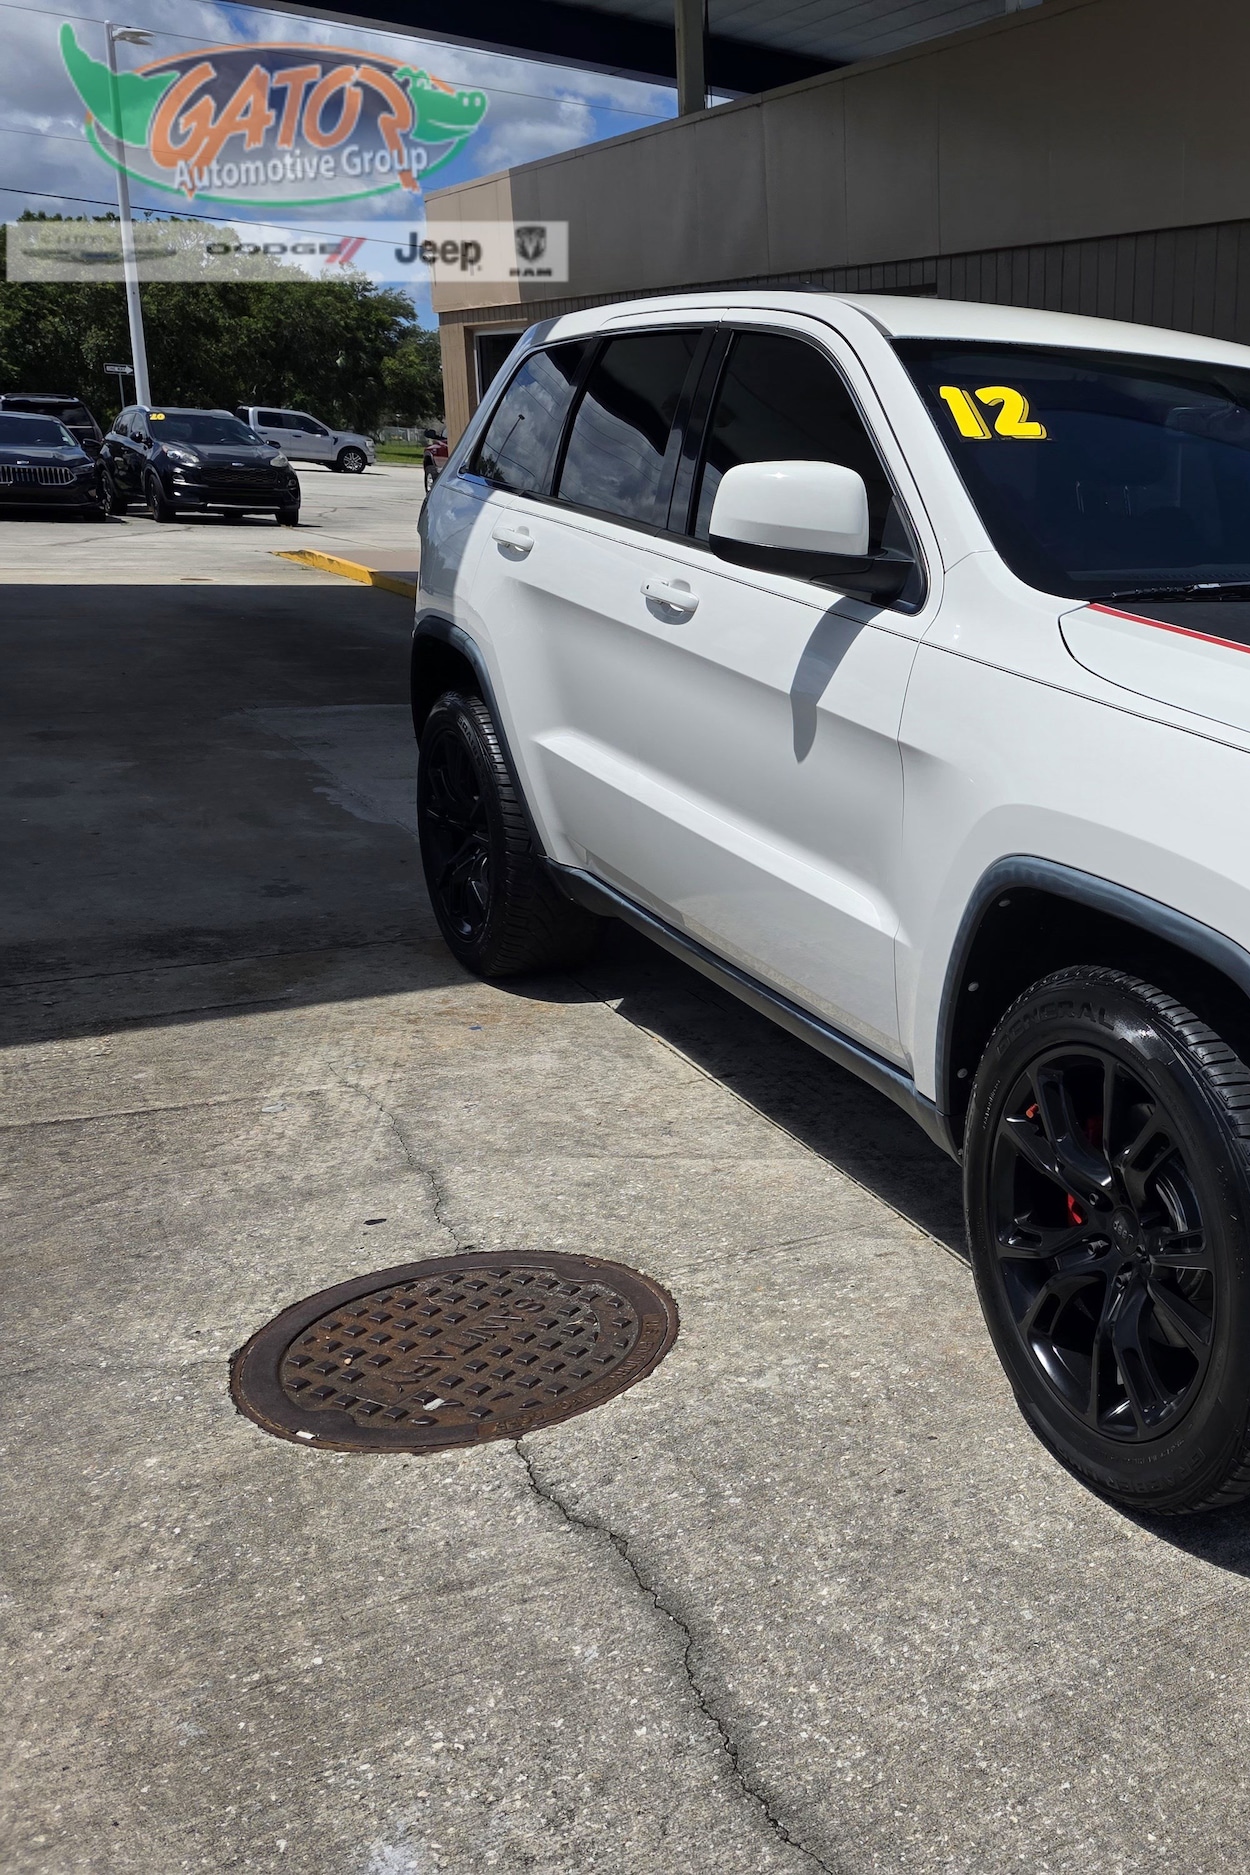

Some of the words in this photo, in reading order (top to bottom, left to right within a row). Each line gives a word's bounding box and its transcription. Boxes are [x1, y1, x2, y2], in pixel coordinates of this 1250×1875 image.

[149, 413, 166, 421] 20
[939, 386, 1047, 440] 12
[995, 1000, 1116, 1058] GENERAL
[1105, 1447, 1206, 1494] GRABBER
